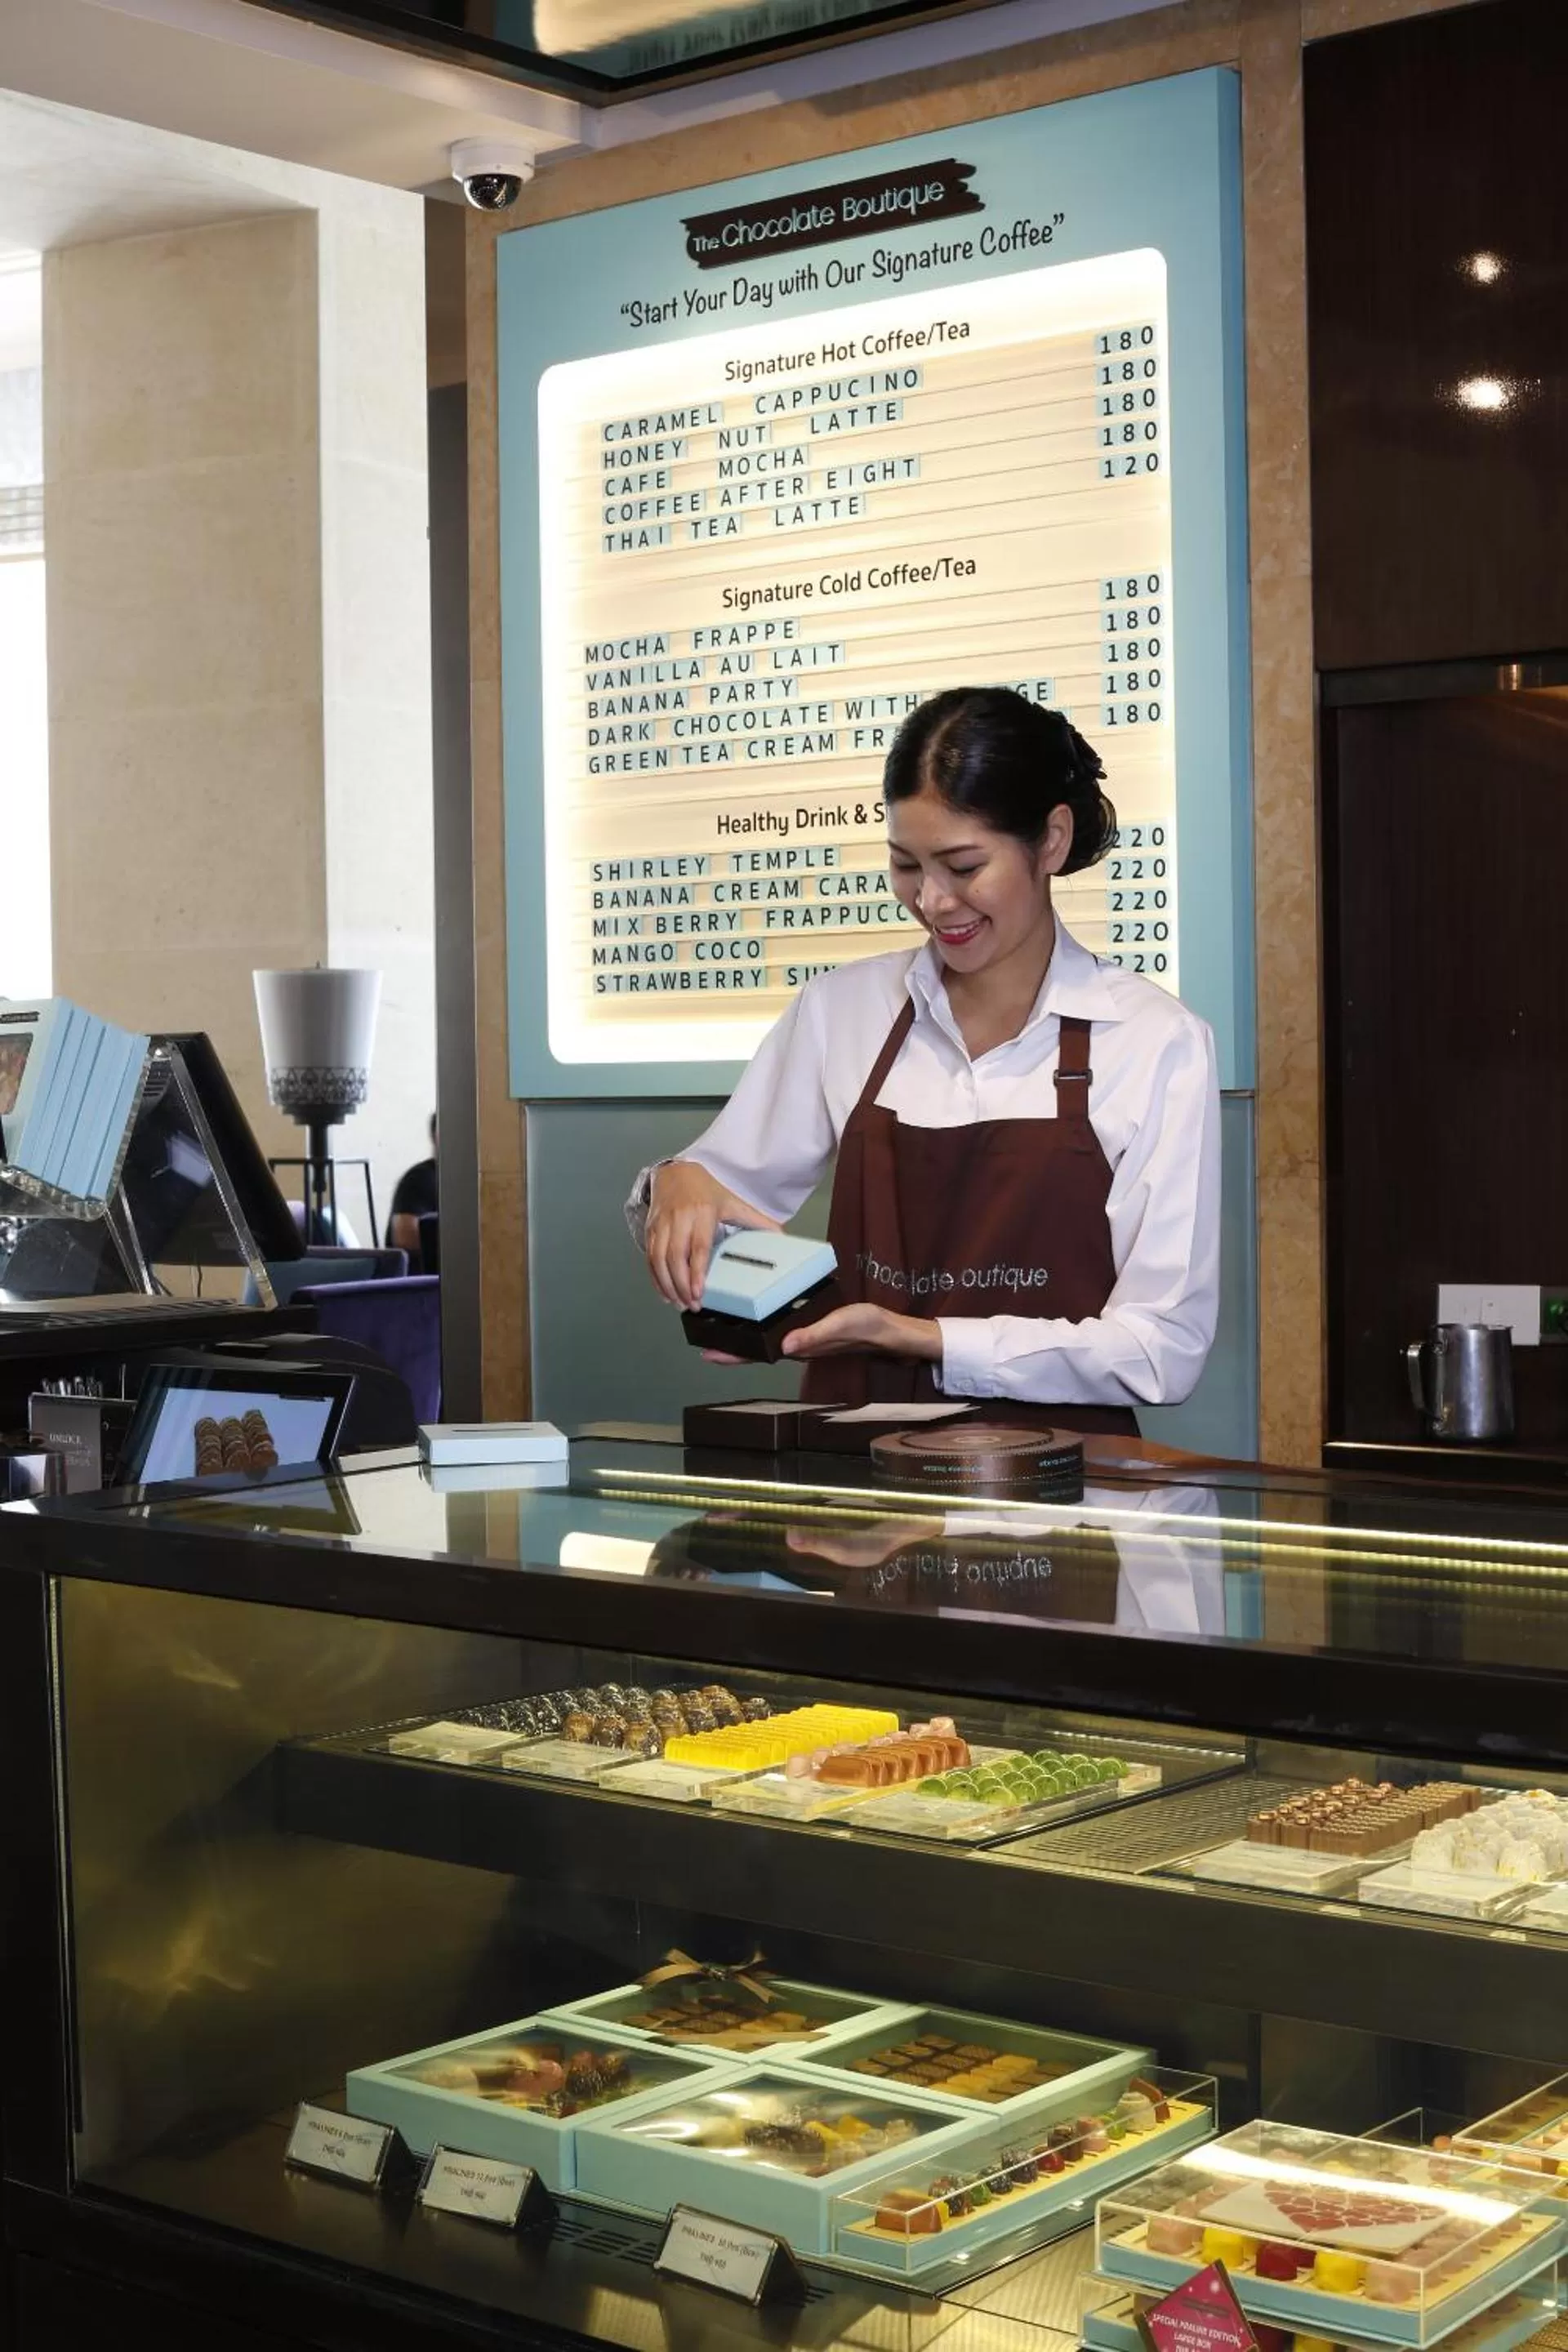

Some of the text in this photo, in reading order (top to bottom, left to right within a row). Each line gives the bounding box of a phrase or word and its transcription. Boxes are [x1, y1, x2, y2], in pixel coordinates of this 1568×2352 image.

[693, 180, 945, 252] The Chocolate Boutique
[683, 283, 727, 318] Your
[733, 275, 773, 309] Day
[777, 263, 819, 296] with
[825, 259, 866, 288] Our
[872, 238, 974, 283] Signature
[724, 321, 971, 382] Signature Hot Coffee/Tea
[1100, 325, 1153, 354] 180
[1102, 358, 1156, 385] 180
[604, 368, 919, 443] CARAMEL CAPPUCINO
[1102, 388, 1156, 416] 180
[604, 402, 898, 470] HONEY NUT LATTE
[1102, 421, 1157, 447] 180
[604, 447, 804, 497] CAFE MOCHA
[1103, 452, 1159, 479] 120
[604, 458, 916, 525] COFFEE AFTER EIGHT
[605, 495, 860, 553] THAI TEA LATTE
[722, 557, 977, 610] Signature Cold Coffee/Tea
[1104, 574, 1160, 600] 180
[1105, 606, 1161, 632] 180
[586, 621, 795, 663] MOCHA FRAPPE
[1107, 638, 1161, 663] 180
[586, 644, 840, 691] VANILLA AU LAIT
[1106, 668, 1161, 694] 180
[588, 679, 795, 719] BANANA PARTY
[1106, 702, 1161, 726] 180
[588, 693, 917, 746] DARK CHOCOLATE WITH
[589, 748, 669, 775] GREEN
[683, 742, 729, 765] TEA
[747, 733, 835, 760] CREAM
[717, 810, 790, 836] Healthy
[795, 805, 848, 829] Drink
[853, 803, 868, 825] &
[1111, 826, 1165, 849] 220
[592, 848, 836, 882] SHIRLEY TEMPLE
[1111, 858, 1167, 880] 220
[593, 874, 889, 910] BANANA CREAM CARA
[1111, 890, 1168, 912] 220
[593, 903, 908, 938] MIX BERRY FRAPPUCC
[1112, 921, 1169, 943] 220
[592, 939, 760, 966] MANGO COCO
[596, 969, 764, 993] STRAWBERRY
[960, 1263, 1049, 1294] outique
[1152, 2313, 1178, 2328] SPECIAL
[1209, 2329, 1241, 2345] EDITION
